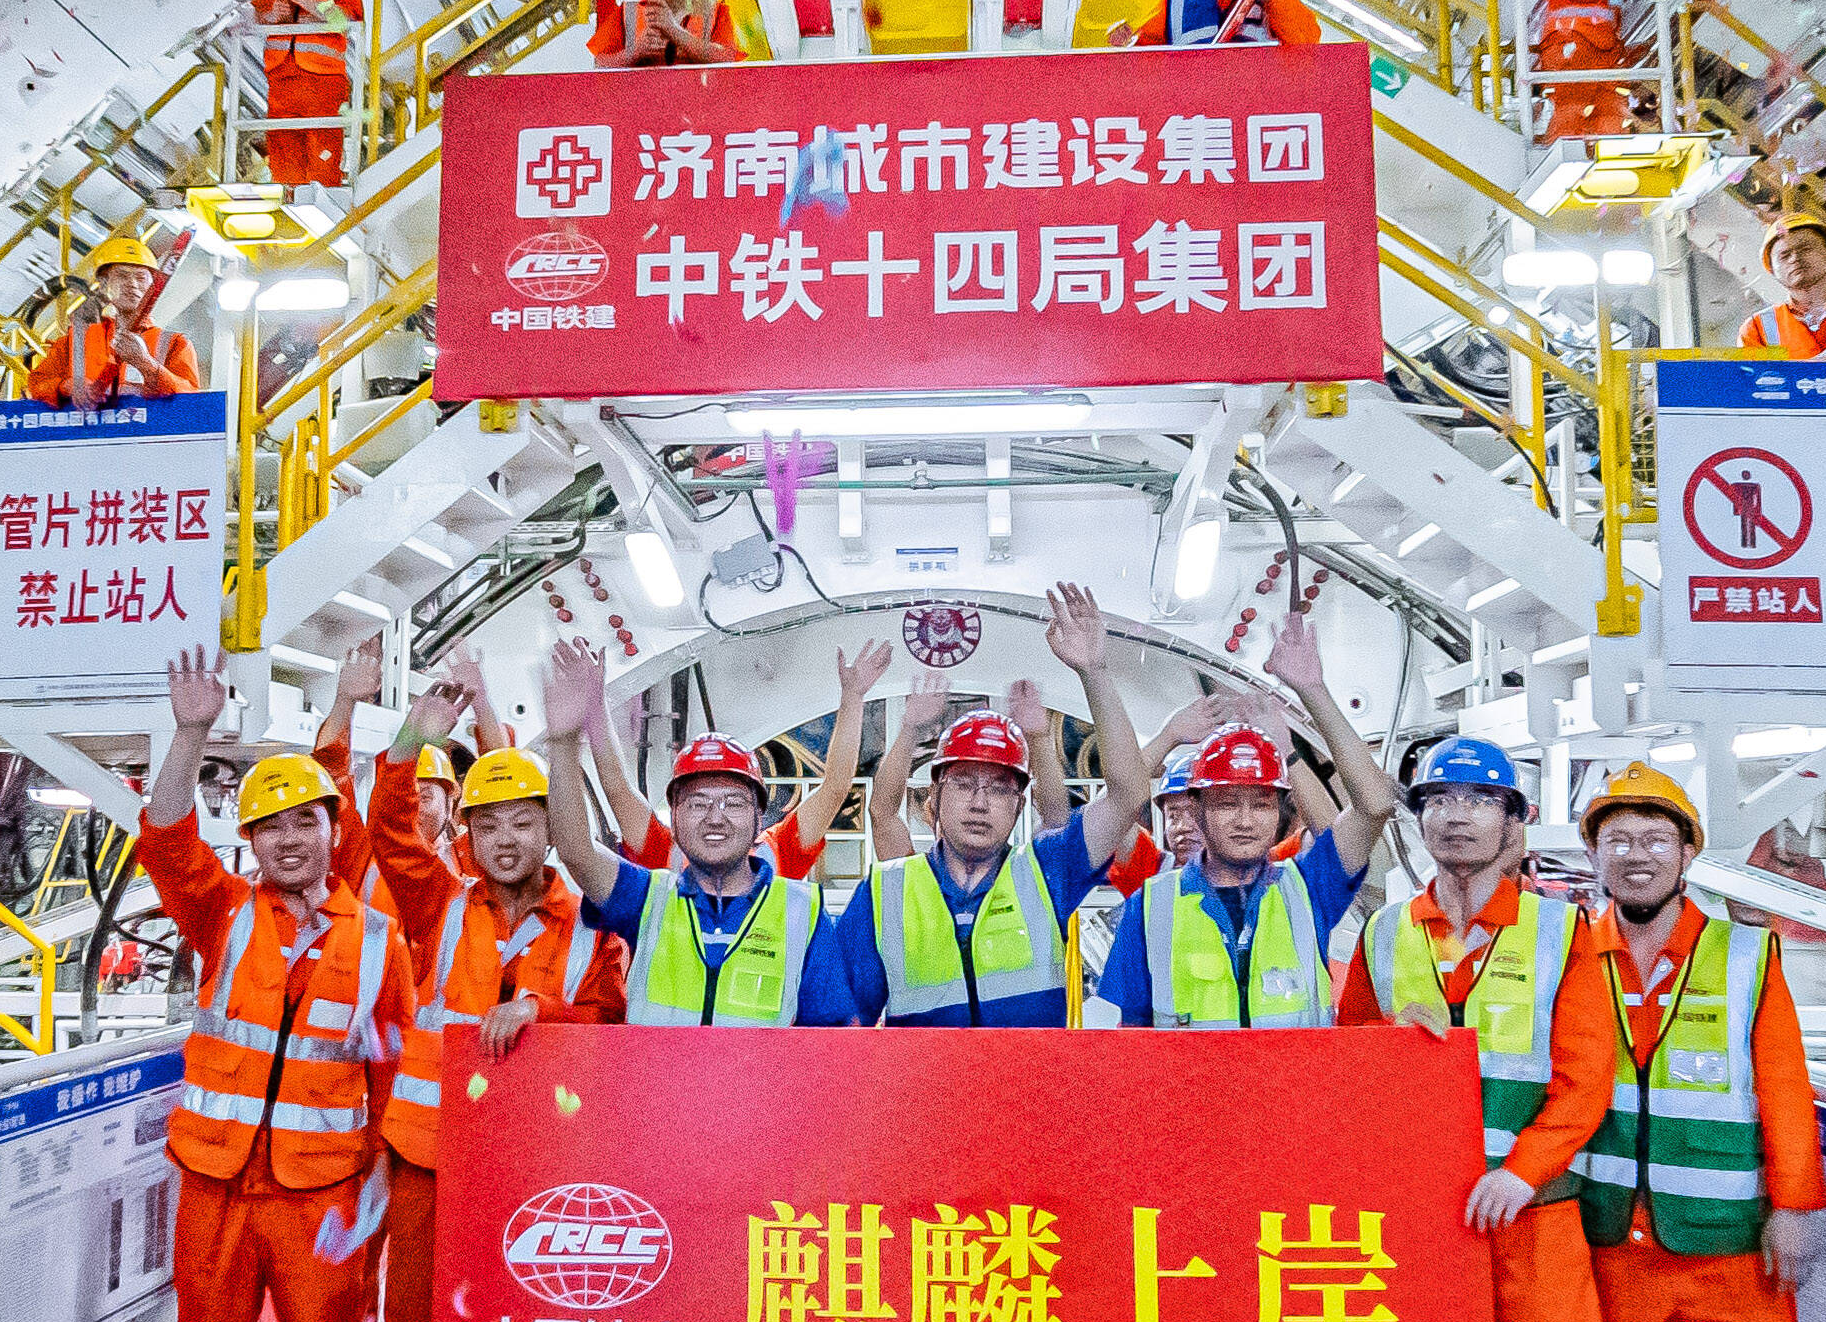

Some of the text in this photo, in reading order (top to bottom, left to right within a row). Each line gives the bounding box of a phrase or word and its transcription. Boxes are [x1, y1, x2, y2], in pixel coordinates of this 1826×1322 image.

[635, 113, 1325, 201] 济南城市建设集团
[635, 217, 1327, 325] 中铁十四局集团
[491, 305, 616, 331] 中国铁建
[0, 487, 210, 549] 管片拼装区
[18, 567, 187, 628] 禁止站人
[1691, 586, 1820, 615] 严禁站人
